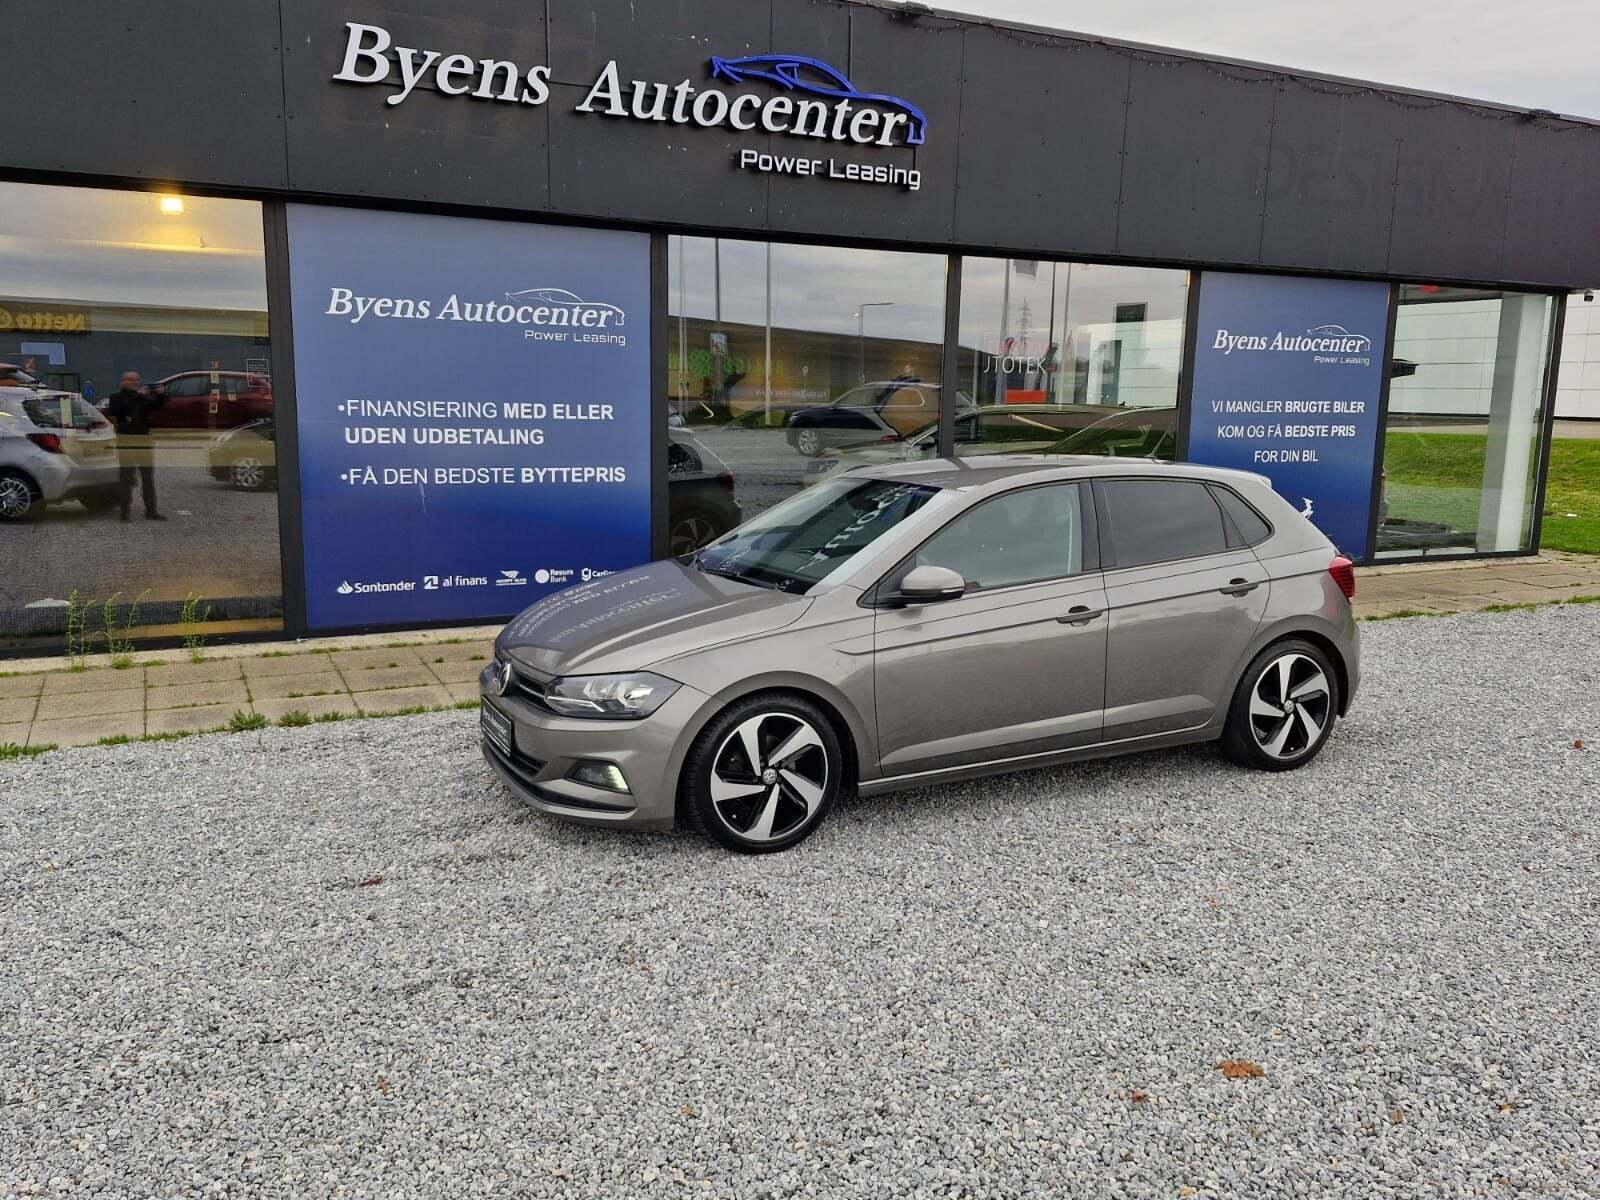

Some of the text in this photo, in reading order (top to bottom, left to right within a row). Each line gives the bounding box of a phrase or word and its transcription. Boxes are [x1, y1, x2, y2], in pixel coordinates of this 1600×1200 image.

[333, 22, 906, 146] Byens Autocenter
[741, 149, 922, 190] Power Leasing
[326, 287, 613, 328] Byens Autocenter
[525, 330, 626, 346] Power Leasing
[1213, 329, 1365, 354] Byens Autocenter
[1314, 355, 1370, 366] Power Leasing
[347, 400, 614, 420] FINANSIERING MED ELLER
[1212, 400, 1365, 413] VI MANGLER BRUGTE BILER
[345, 427, 544, 445] UDEN UDBETALING
[1218, 423, 1356, 438] KOM OG FÅ BEDSTE PRIS
[1254, 450, 1319, 463] FOR DIN BIL
[349, 466, 626, 485] FÅ DEN BEDSTE BYTTEPRIS
[354, 580, 416, 593] Santander
[442, 576, 453, 587] al
[455, 575, 488, 587] finans
